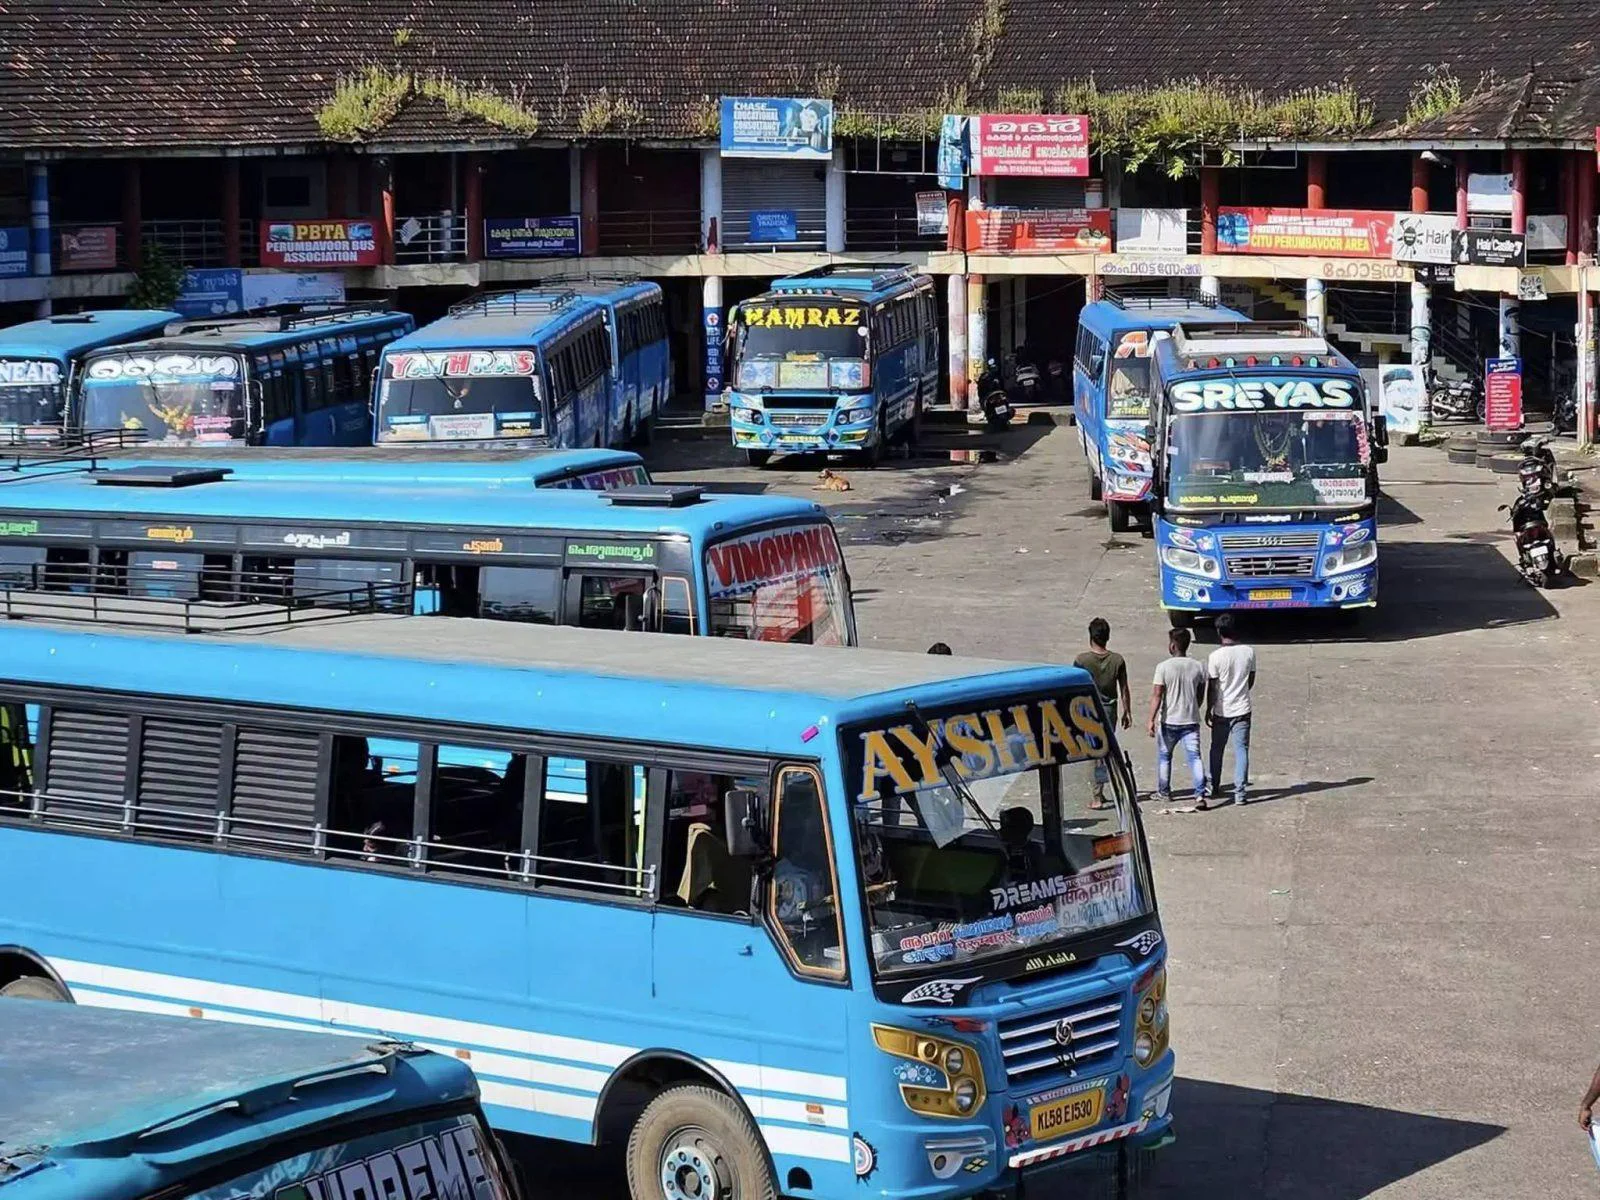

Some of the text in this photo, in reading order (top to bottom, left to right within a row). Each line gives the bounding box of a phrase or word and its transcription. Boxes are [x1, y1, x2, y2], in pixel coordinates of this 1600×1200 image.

[734, 102, 768, 111] CHASE
[296, 224, 346, 240] PBTA
[1425, 229, 1449, 245] Hair
[266, 240, 376, 252] PERUMBAVOOR BUS
[1251, 234, 1370, 252] CITU PERUMBAVOOR AREA
[1476, 238, 1492, 251] Hair
[284, 251, 358, 263] ASSOCIATION
[385, 350, 536, 379] YATHRAS
[1170, 380, 1354, 411] SREYAS
[567, 543, 655, 561] പെരുമ്പാവൂർ
[708, 525, 840, 588] VINAYAKA
[857, 695, 1109, 803] AYSHAS
[990, 875, 1068, 909] DREAMS
[1038, 1106, 1063, 1131] KL58
[276, 1124, 496, 1200] PREME
